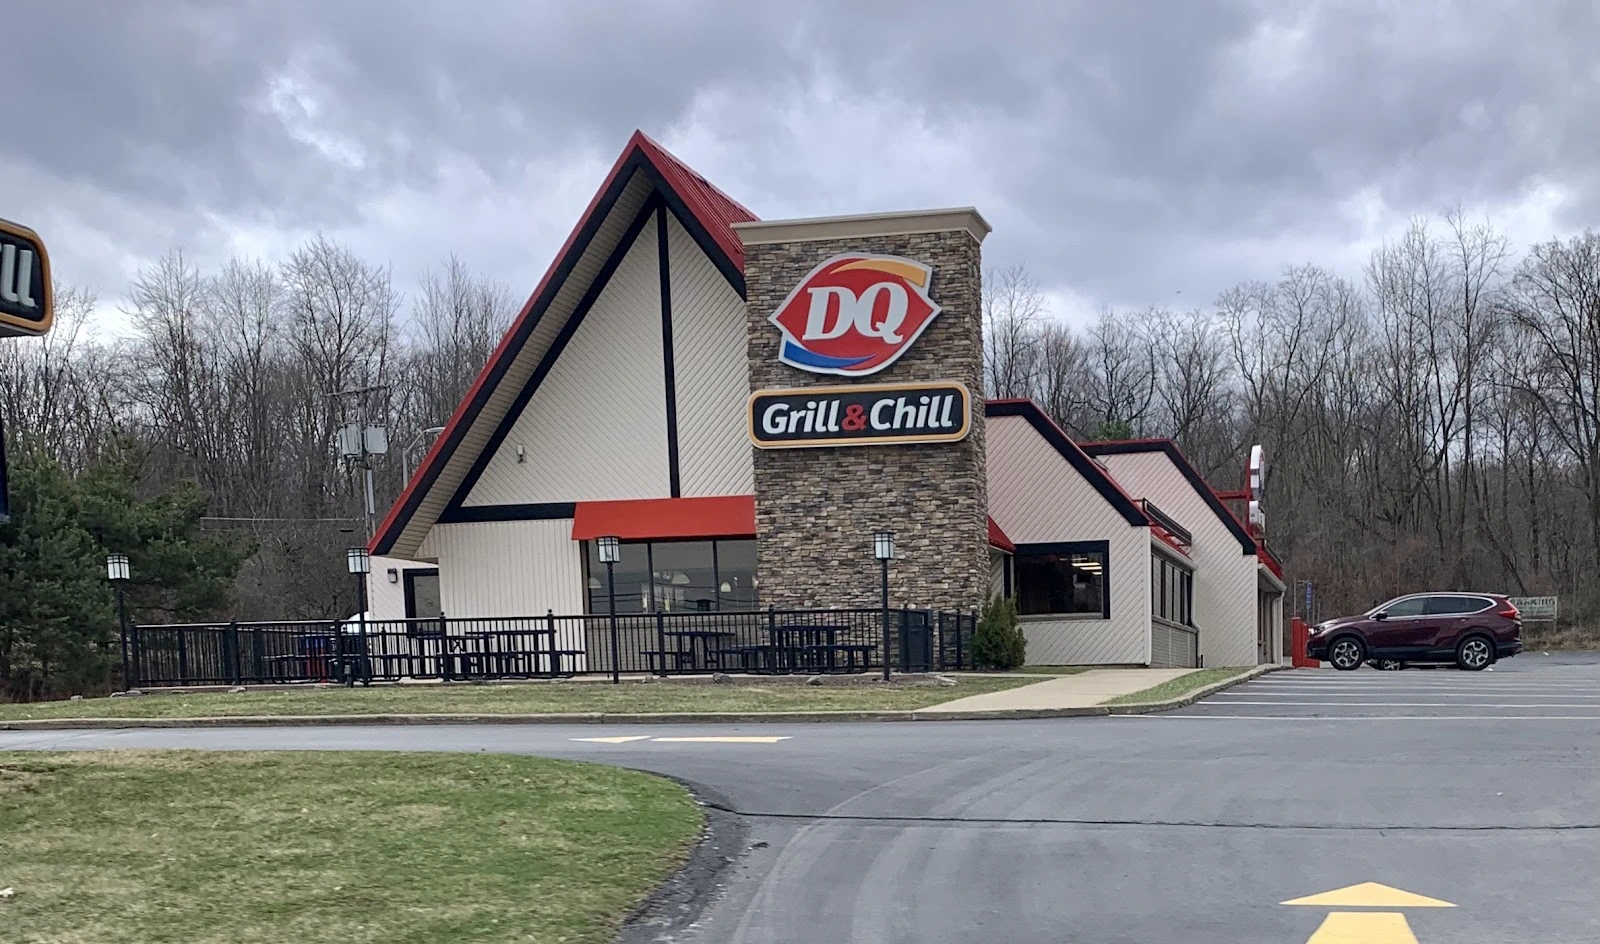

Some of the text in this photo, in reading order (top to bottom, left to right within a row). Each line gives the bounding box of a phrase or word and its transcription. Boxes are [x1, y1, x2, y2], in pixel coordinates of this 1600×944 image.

[802, 281, 909, 344] DQ
[762, 400, 840, 434] Grill
[870, 394, 954, 430] Chill
